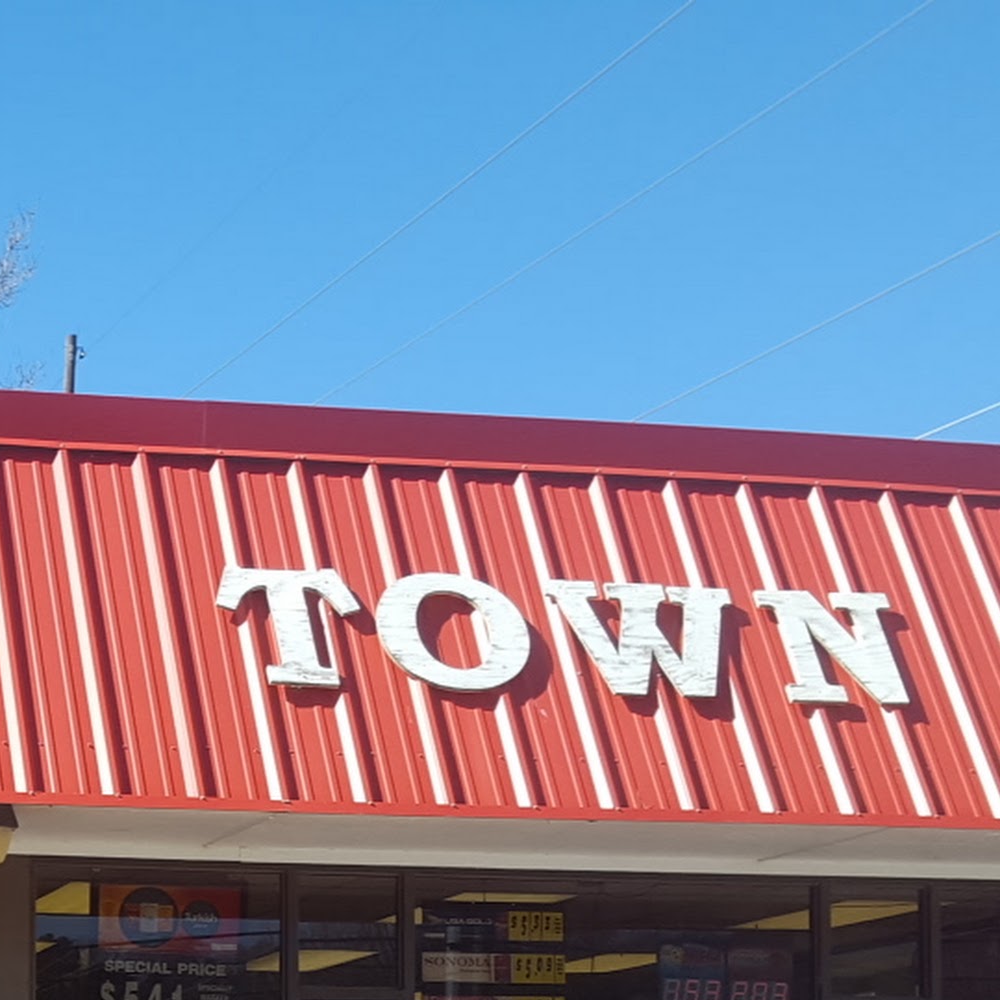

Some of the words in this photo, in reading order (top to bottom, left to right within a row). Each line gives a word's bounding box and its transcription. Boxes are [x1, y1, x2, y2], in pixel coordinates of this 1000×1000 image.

[215, 566, 911, 706] TOWN
[104, 960, 172, 975] SPECIAL
[177, 962, 227, 977] PRICE
[424, 956, 491, 967] SONOMA
